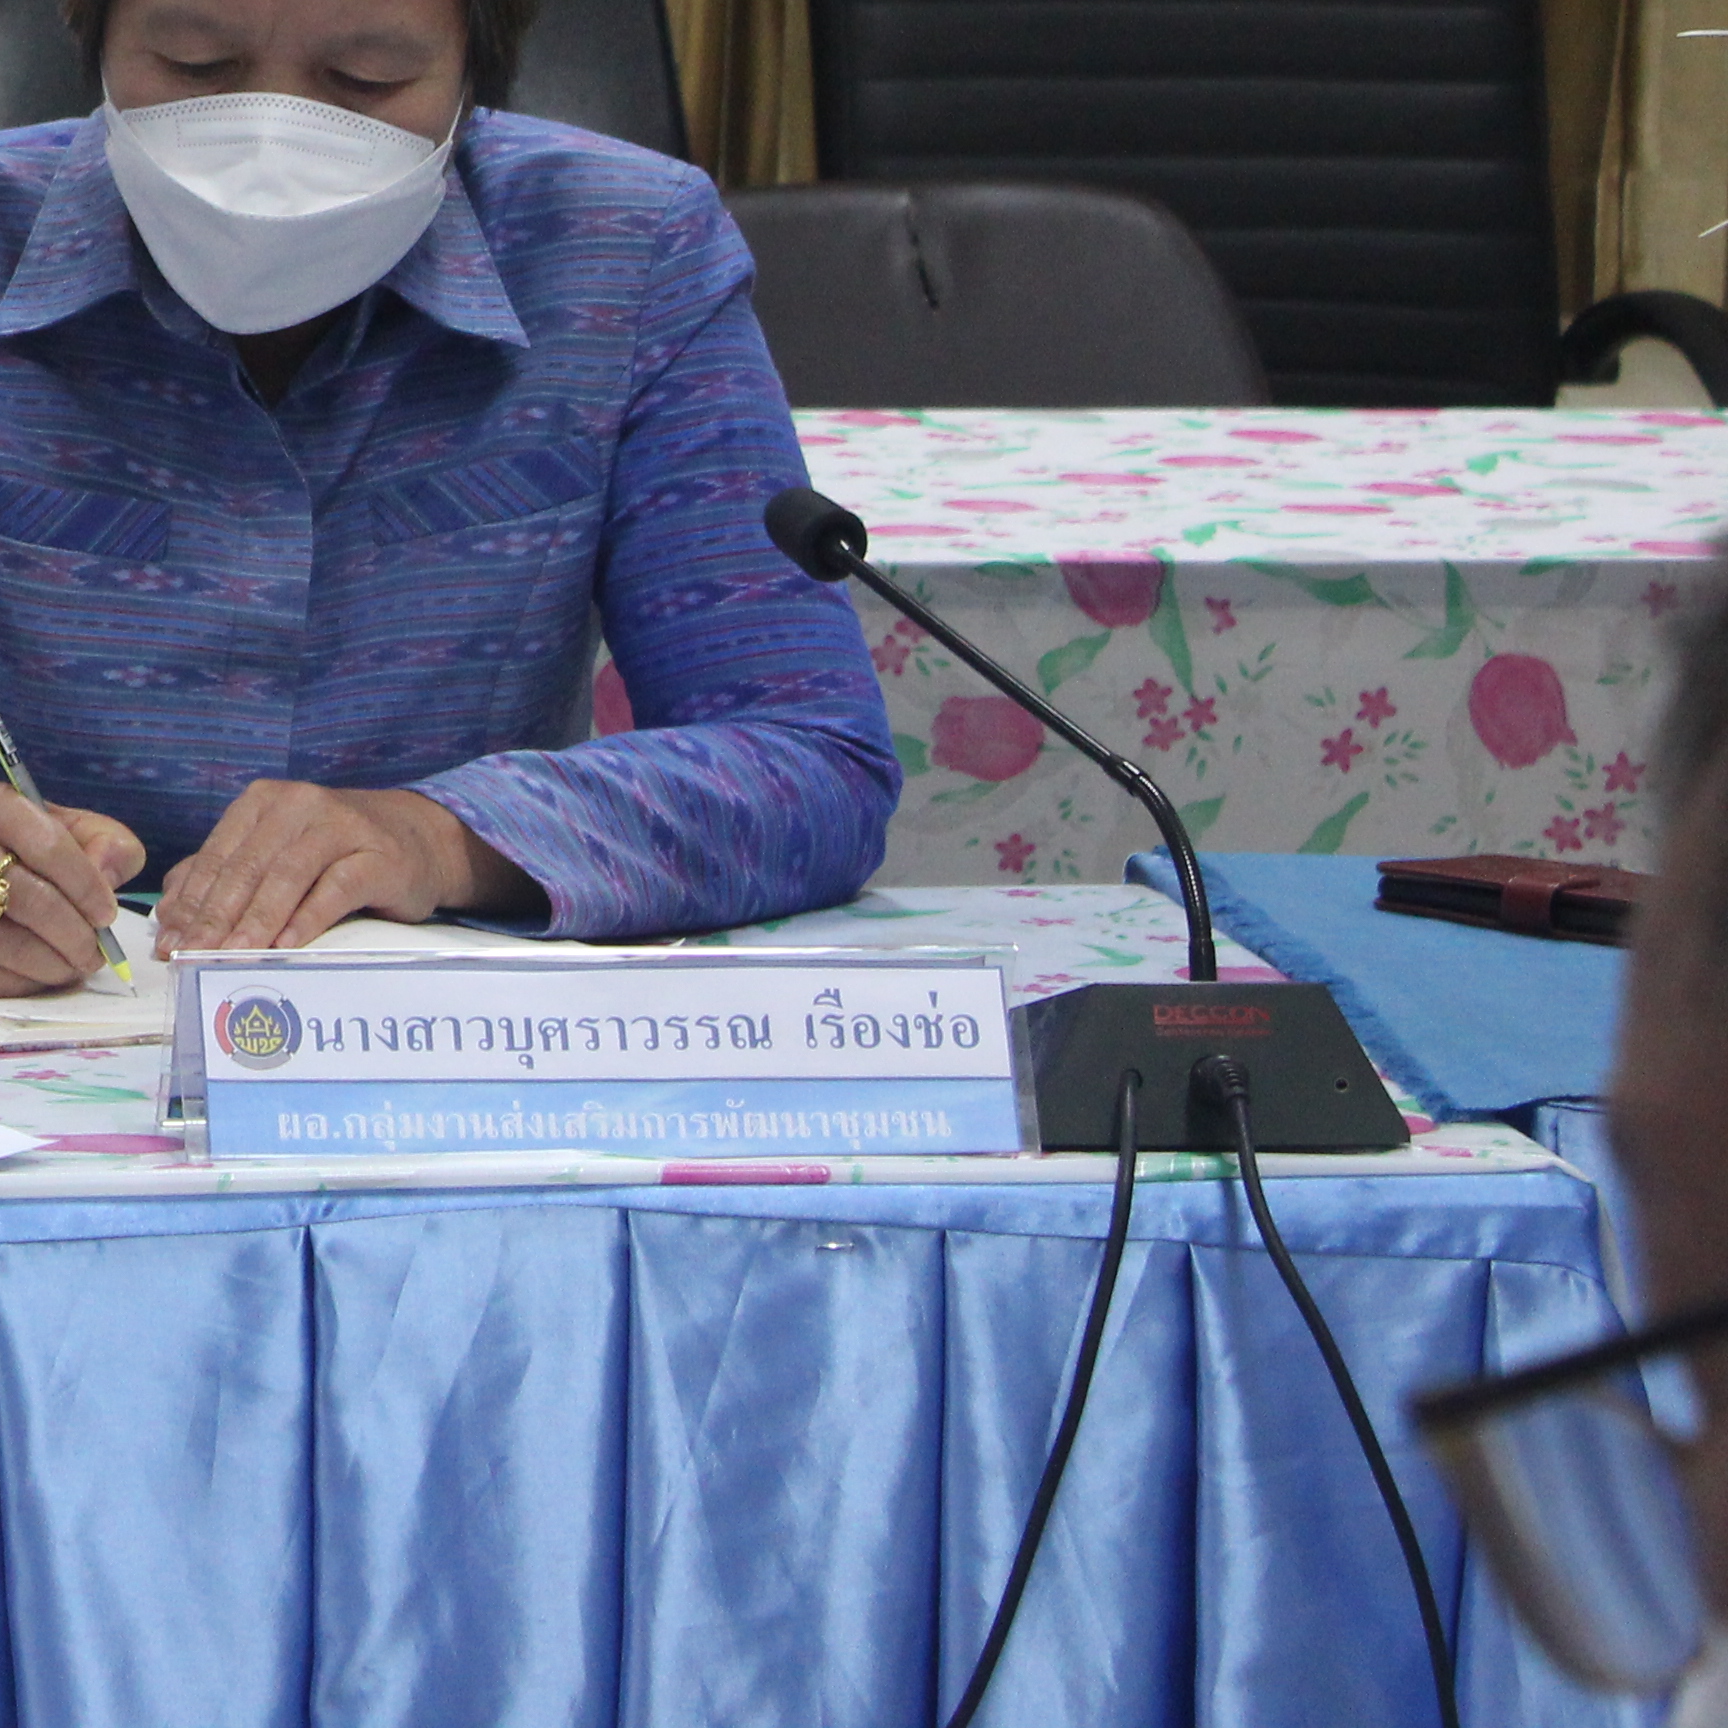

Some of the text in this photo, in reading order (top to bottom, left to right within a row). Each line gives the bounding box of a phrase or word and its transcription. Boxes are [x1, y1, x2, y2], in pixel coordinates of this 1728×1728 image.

[306, 988, 981, 1070] นางสาวบุศราวรรณ เรืองช่อ
[278, 1099, 954, 1151] ผอ.กลุ่มงานส่งเสริมการพัฒนาชุมชน
